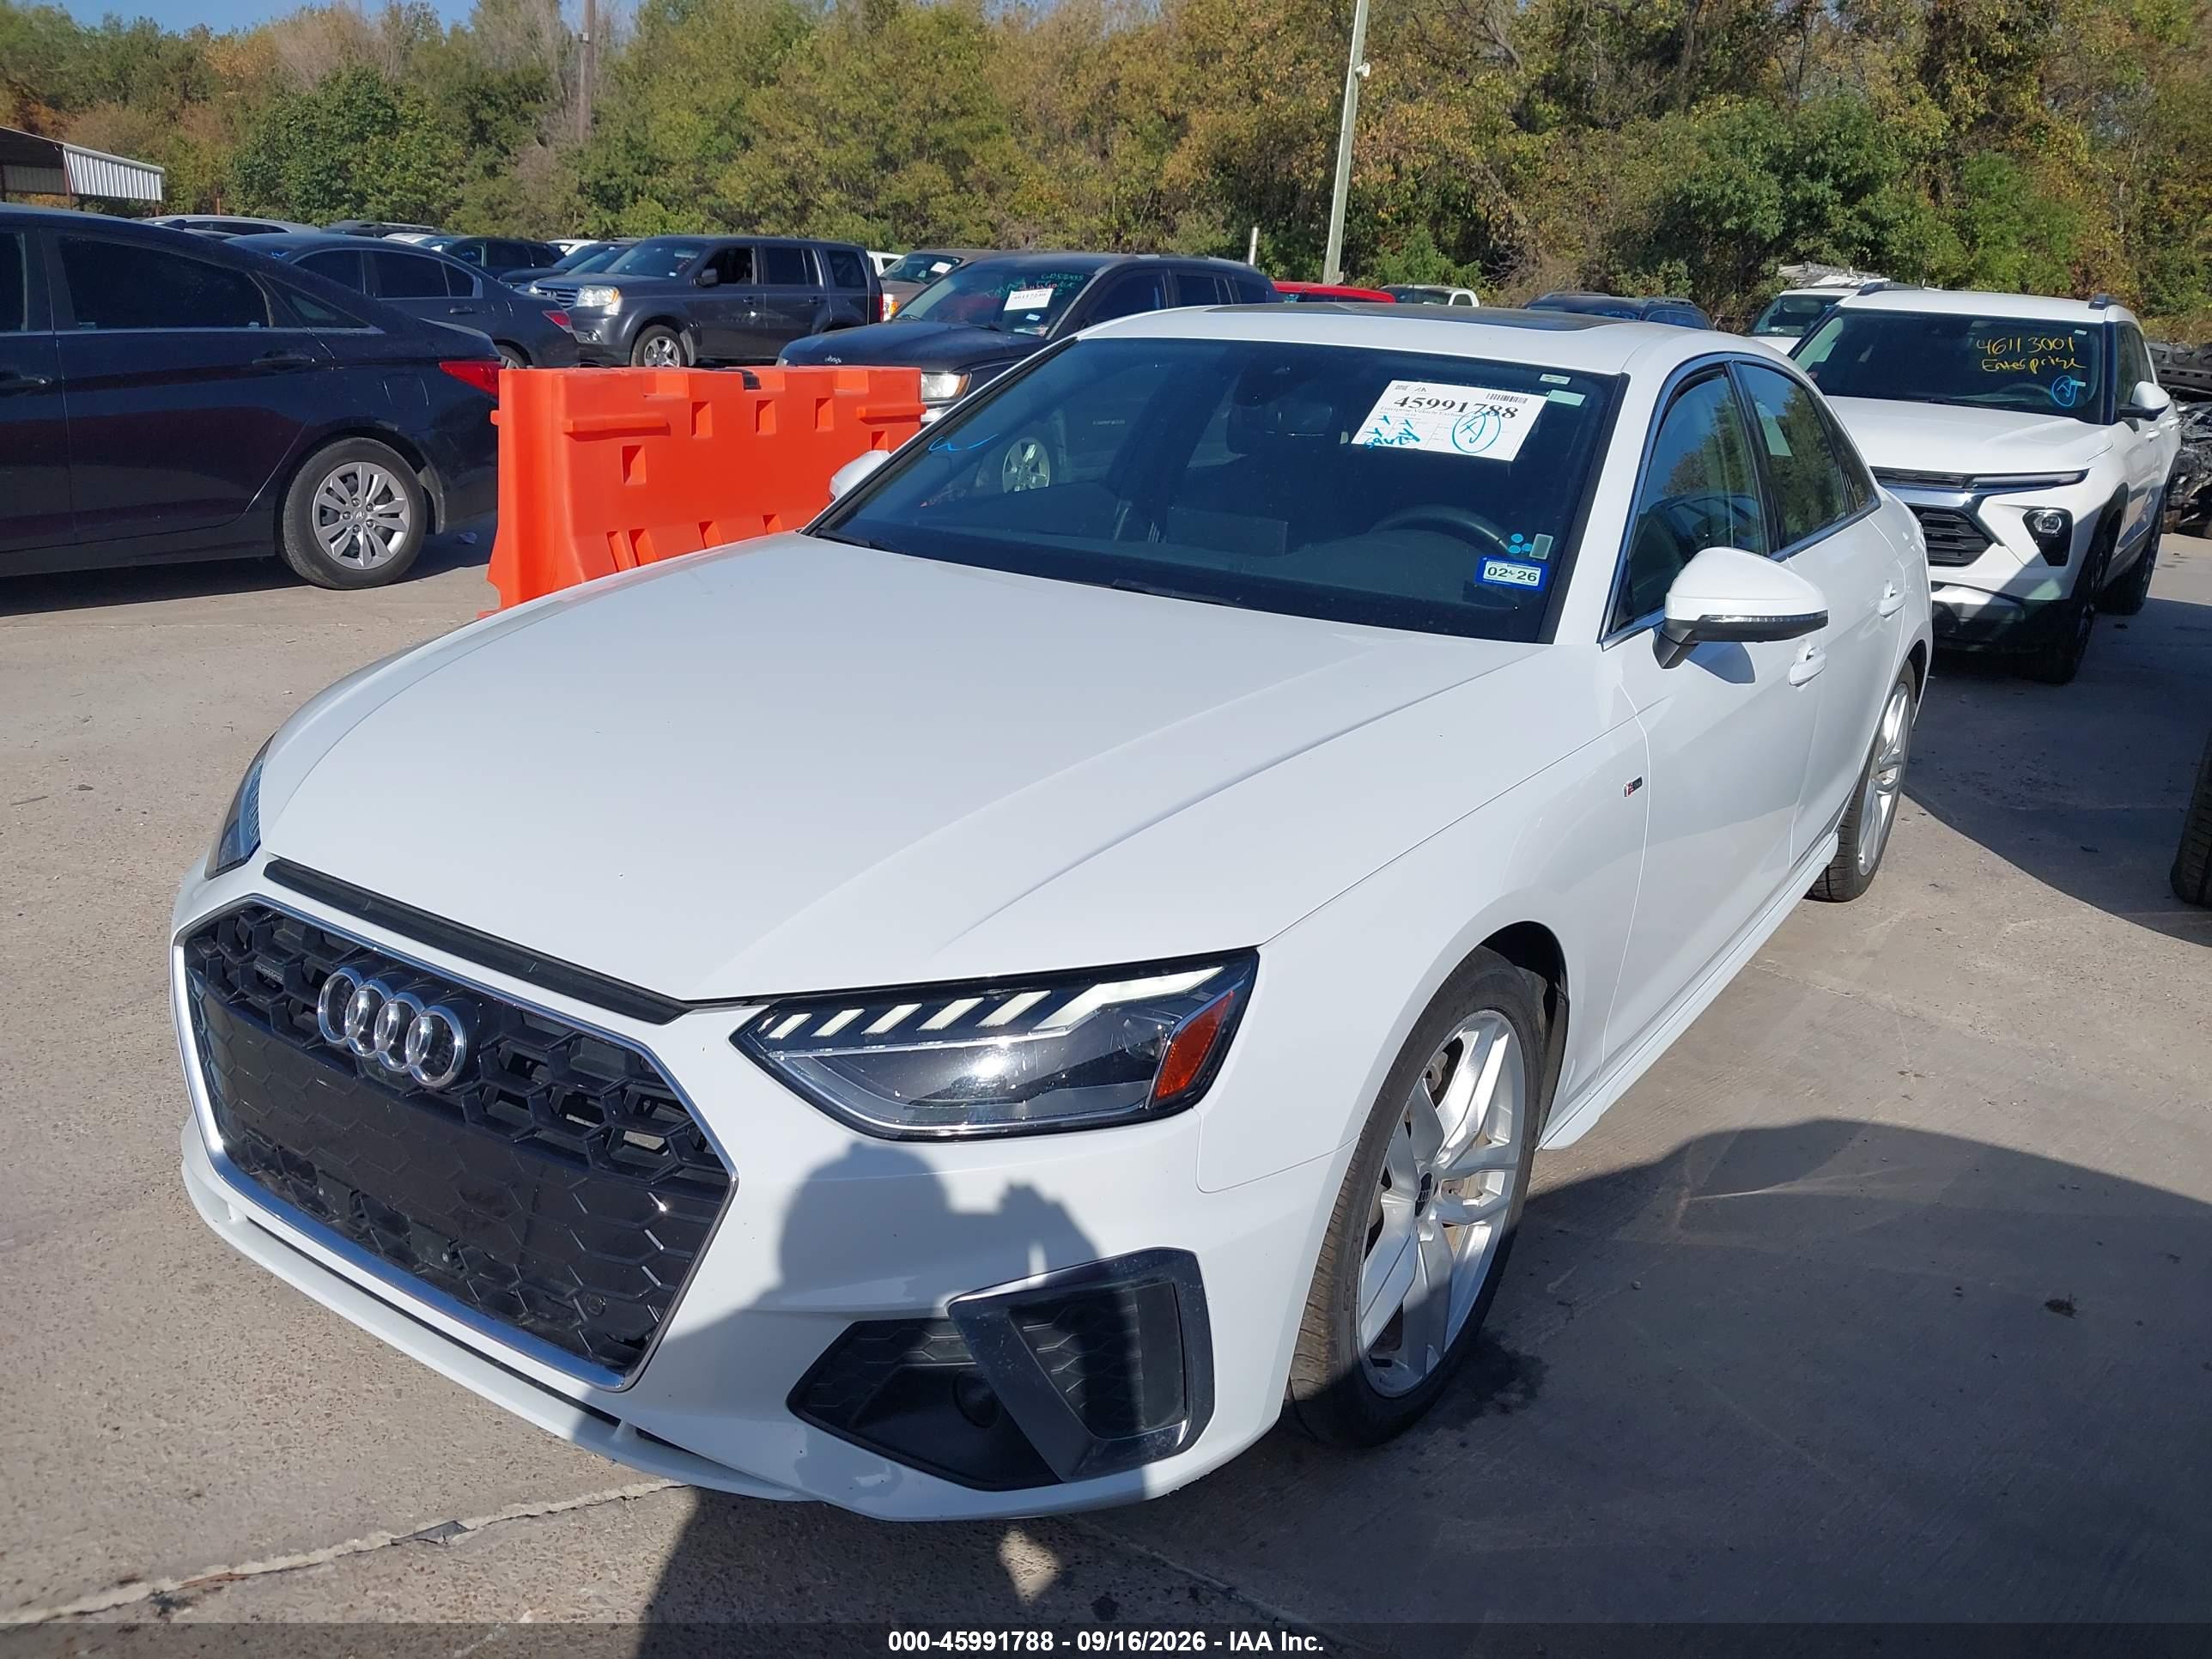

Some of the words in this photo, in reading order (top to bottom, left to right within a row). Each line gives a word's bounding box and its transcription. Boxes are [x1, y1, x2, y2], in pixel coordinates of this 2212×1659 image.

[1394, 395, 1519, 419] 45991788
[1487, 566, 1508, 578] 02
[1516, 570, 1538, 581] 26
